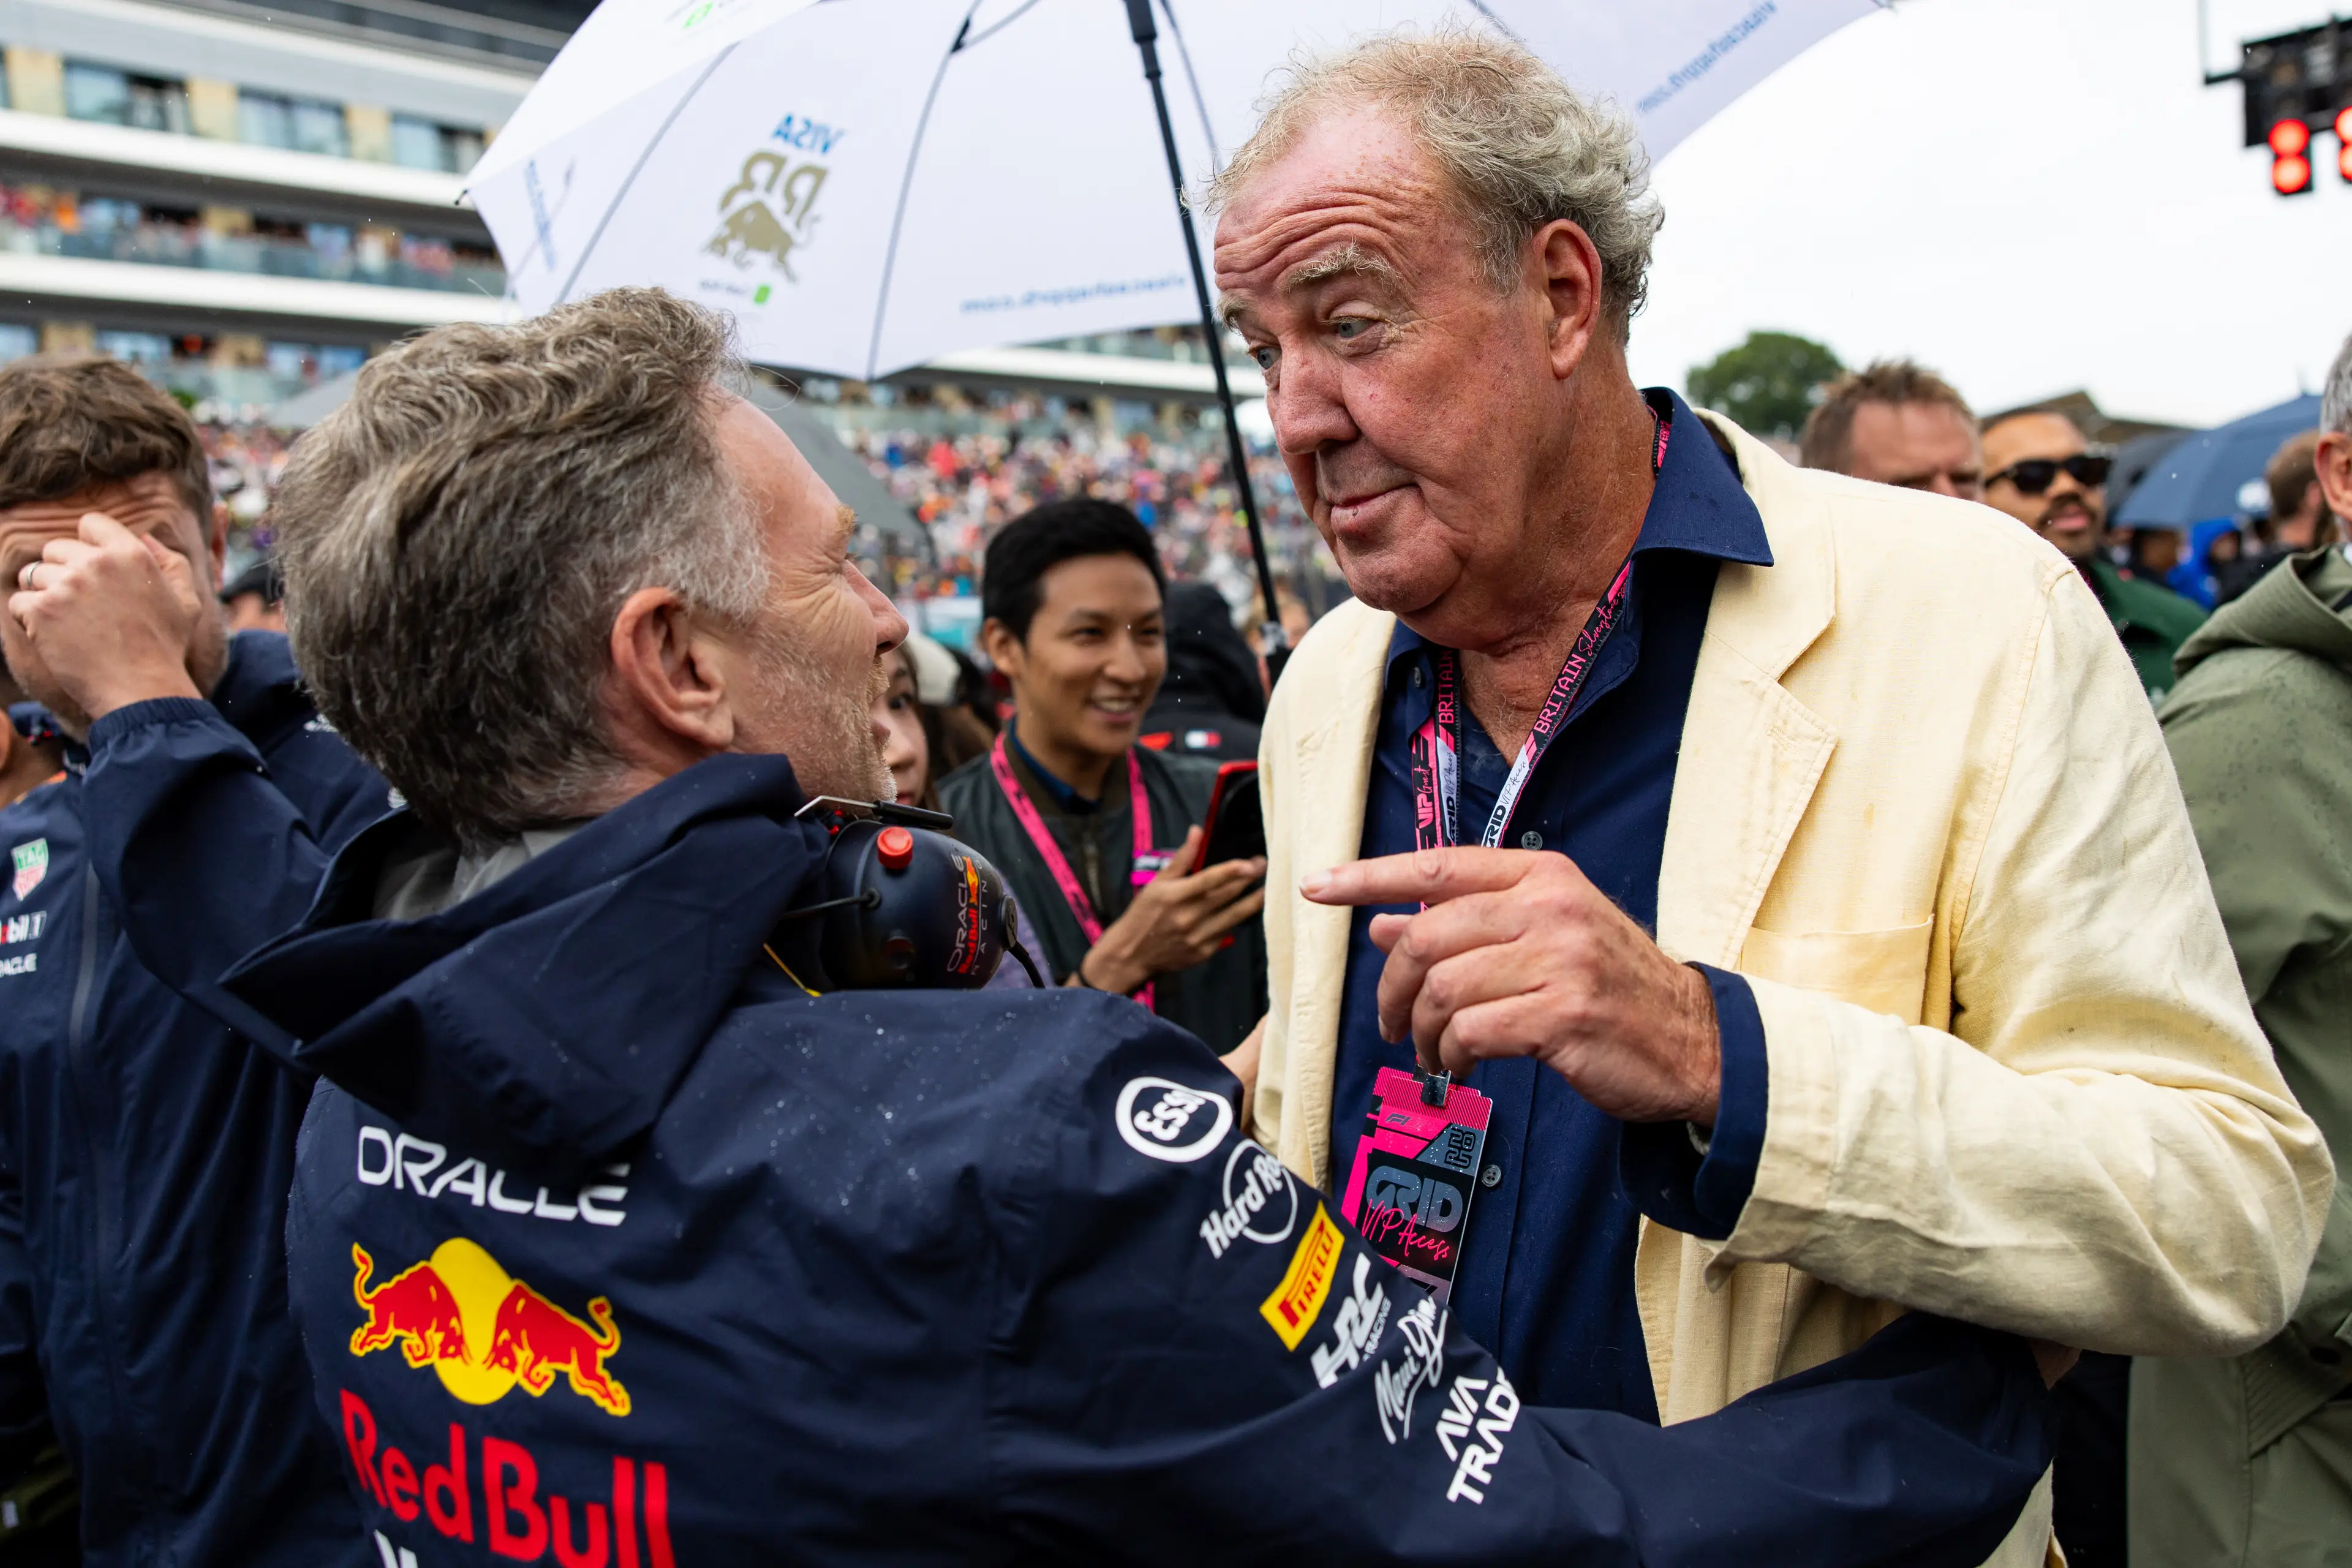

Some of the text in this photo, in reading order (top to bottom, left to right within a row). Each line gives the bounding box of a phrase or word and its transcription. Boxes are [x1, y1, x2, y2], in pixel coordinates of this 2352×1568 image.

[1438, 650, 1455, 724] BRITAIN
[1534, 654, 1586, 734] BRITAIN
[1578, 598, 1619, 656] Silverstone
[1414, 766, 1434, 829] VIP Guest
[1446, 775, 1455, 797] VIP
[1500, 783, 1512, 805] VIP
[1510, 761, 1526, 786] Access
[947, 853, 968, 973] ORACLE
[957, 908, 978, 973] Red Bull
[971, 859, 988, 975] RACING
[1199, 1168, 1267, 1260] Hard
[1362, 1199, 1450, 1261] VIP Access
[1366, 1166, 1463, 1233] GRID
[1278, 1218, 1335, 1329] PIRELLI
[1365, 1295, 1392, 1355] RACING
[1436, 1376, 1488, 1462] AVA
[340, 1388, 676, 1568] Red Bull
